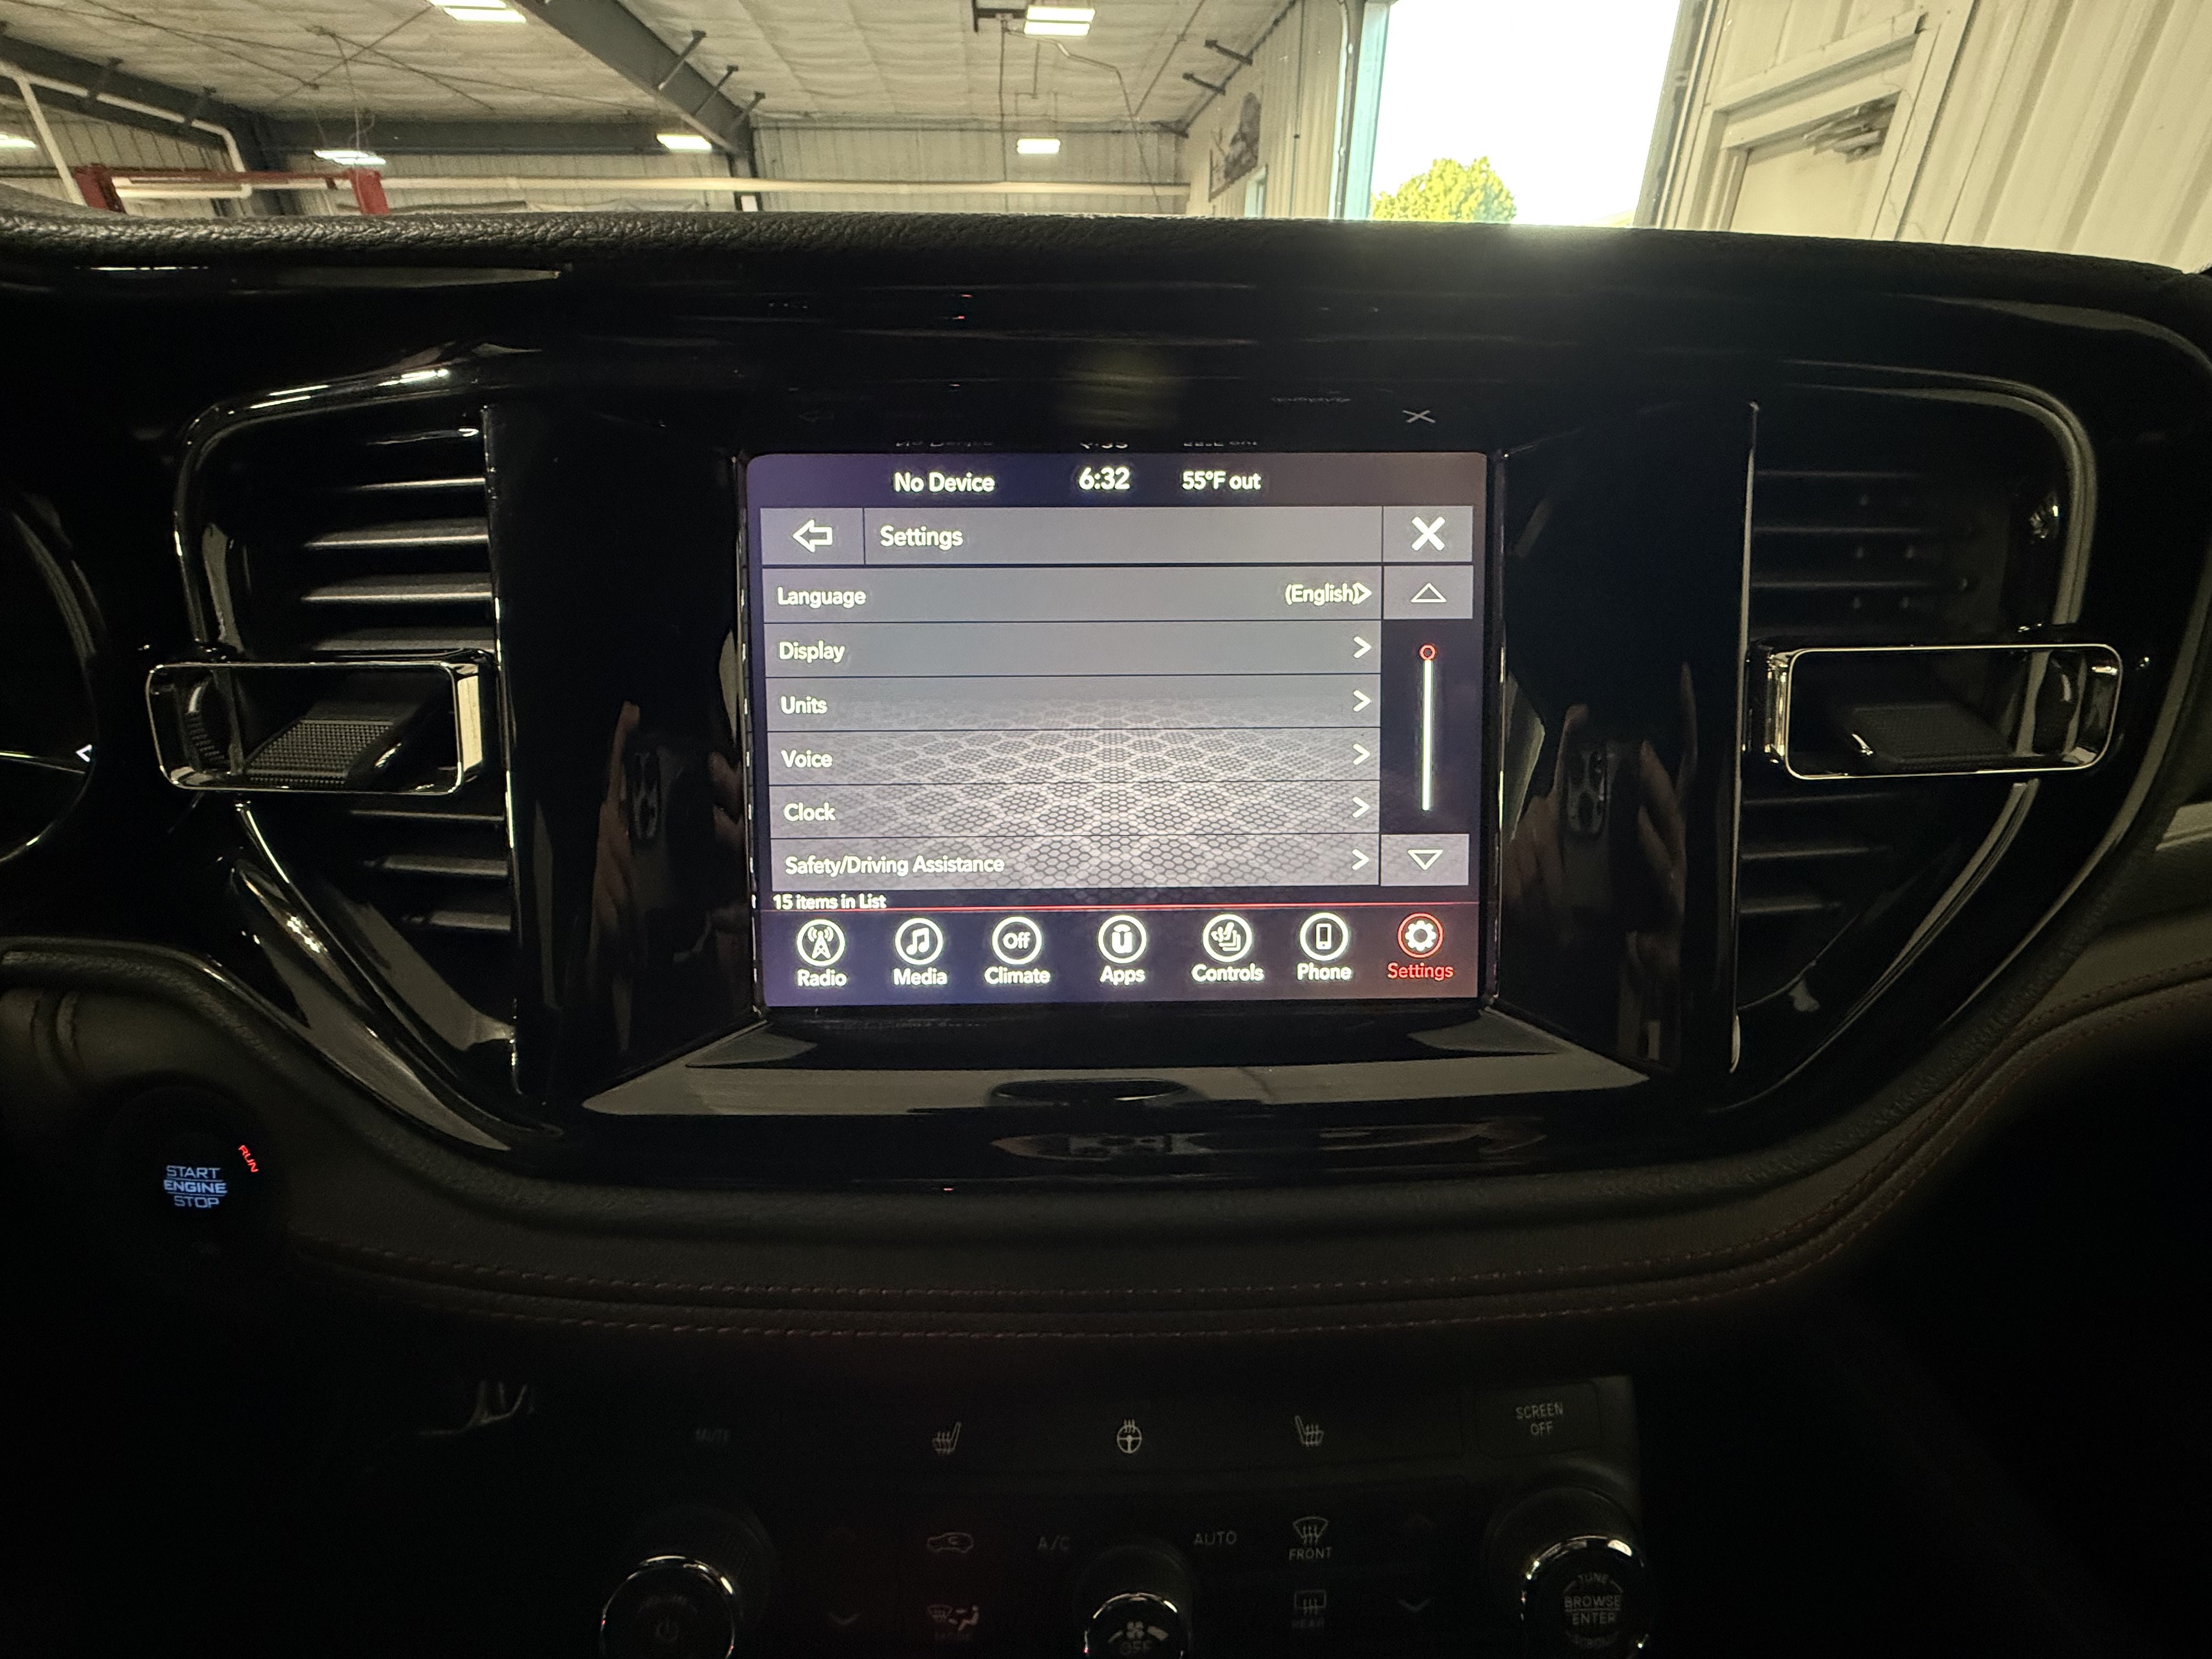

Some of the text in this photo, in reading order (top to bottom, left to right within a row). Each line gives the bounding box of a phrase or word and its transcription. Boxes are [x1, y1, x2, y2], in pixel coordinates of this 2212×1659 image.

[894, 472, 996, 493] No Device
[1079, 467, 1131, 490] 6:32
[1182, 471, 1262, 490] 55°F out
[880, 525, 964, 551] Settings
[777, 587, 866, 608] Language
[779, 640, 845, 663] Display
[780, 696, 828, 714] Units
[781, 750, 833, 768] Voice
[783, 803, 836, 821] Clock
[785, 855, 1005, 876] Safety/Driving Assistance
[772, 893, 887, 910] 15 items in List
[1003, 932, 1030, 950] Off
[797, 969, 848, 987] Radio
[893, 968, 948, 986] Media
[984, 967, 1051, 984] Climate
[1099, 966, 1146, 985] Apps
[1192, 963, 1264, 982] Controls
[1297, 962, 1352, 980] Phone
[1387, 962, 1454, 981] Settings
[238, 1144, 259, 1173] RUN
[166, 1165, 221, 1179] START
[163, 1180, 228, 1194] ENGINE
[173, 1195, 220, 1208] STOP
[1515, 1402, 1564, 1419] SCREEN
[1530, 1421, 1553, 1435] OFF
[1037, 1535, 1070, 1551] A/C
[1194, 1530, 1237, 1545] AUTO
[1289, 1546, 1332, 1561] FRONT
[1564, 1595, 1621, 1608] BROWSE
[1572, 1612, 1616, 1625] ENTER
